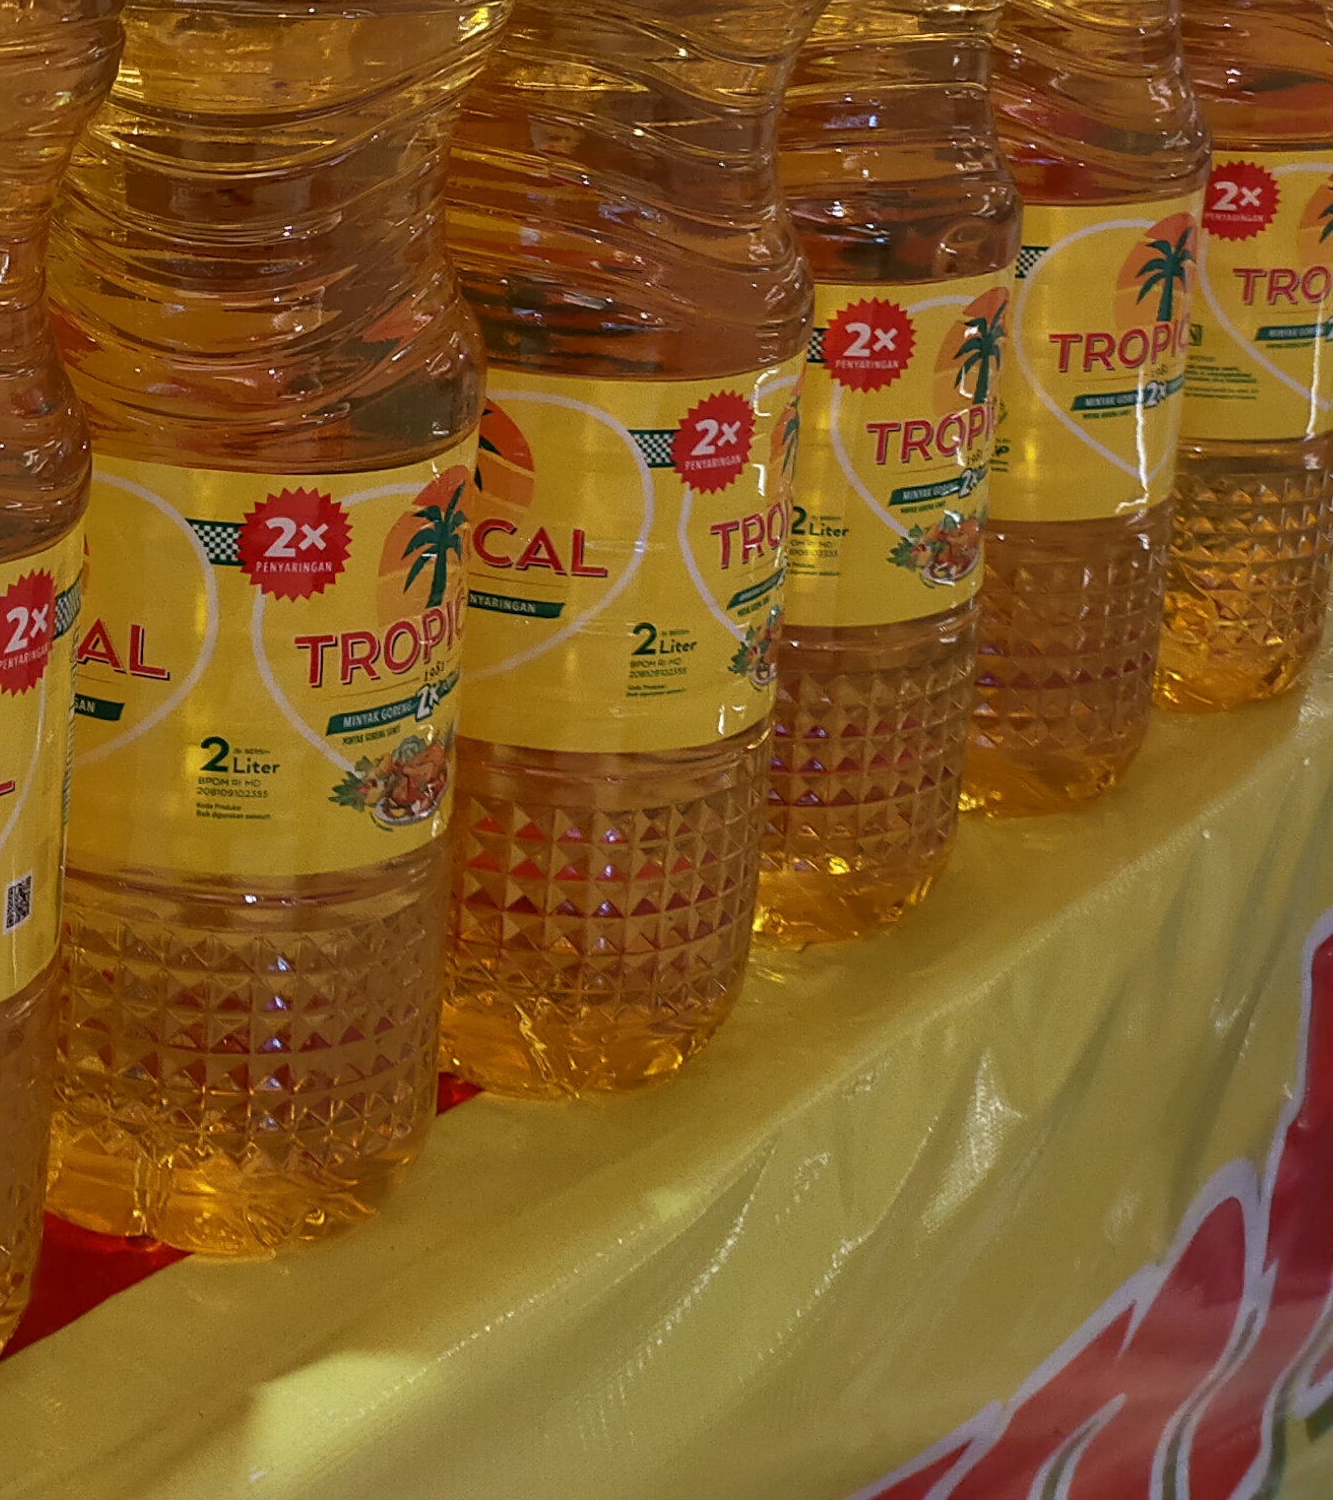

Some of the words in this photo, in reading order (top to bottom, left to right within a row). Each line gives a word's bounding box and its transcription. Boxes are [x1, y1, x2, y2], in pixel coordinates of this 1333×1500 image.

[1213, 181, 1263, 212] 2X
[842, 321, 899, 358] 2X
[690, 417, 741, 457] 2X
[684, 455, 743, 472] PENYARINGAN
[261, 516, 330, 559] 2X
[809, 523, 850, 538] Liter
[254, 560, 333, 574] PENYARINGAN
[4, 602, 49, 655] 2X
[631, 622, 657, 657] 2
[659, 639, 697, 655] Liter
[343, 711, 381, 729] MINYAK
[200, 736, 231, 773] 2
[233, 757, 280, 775] Liter
